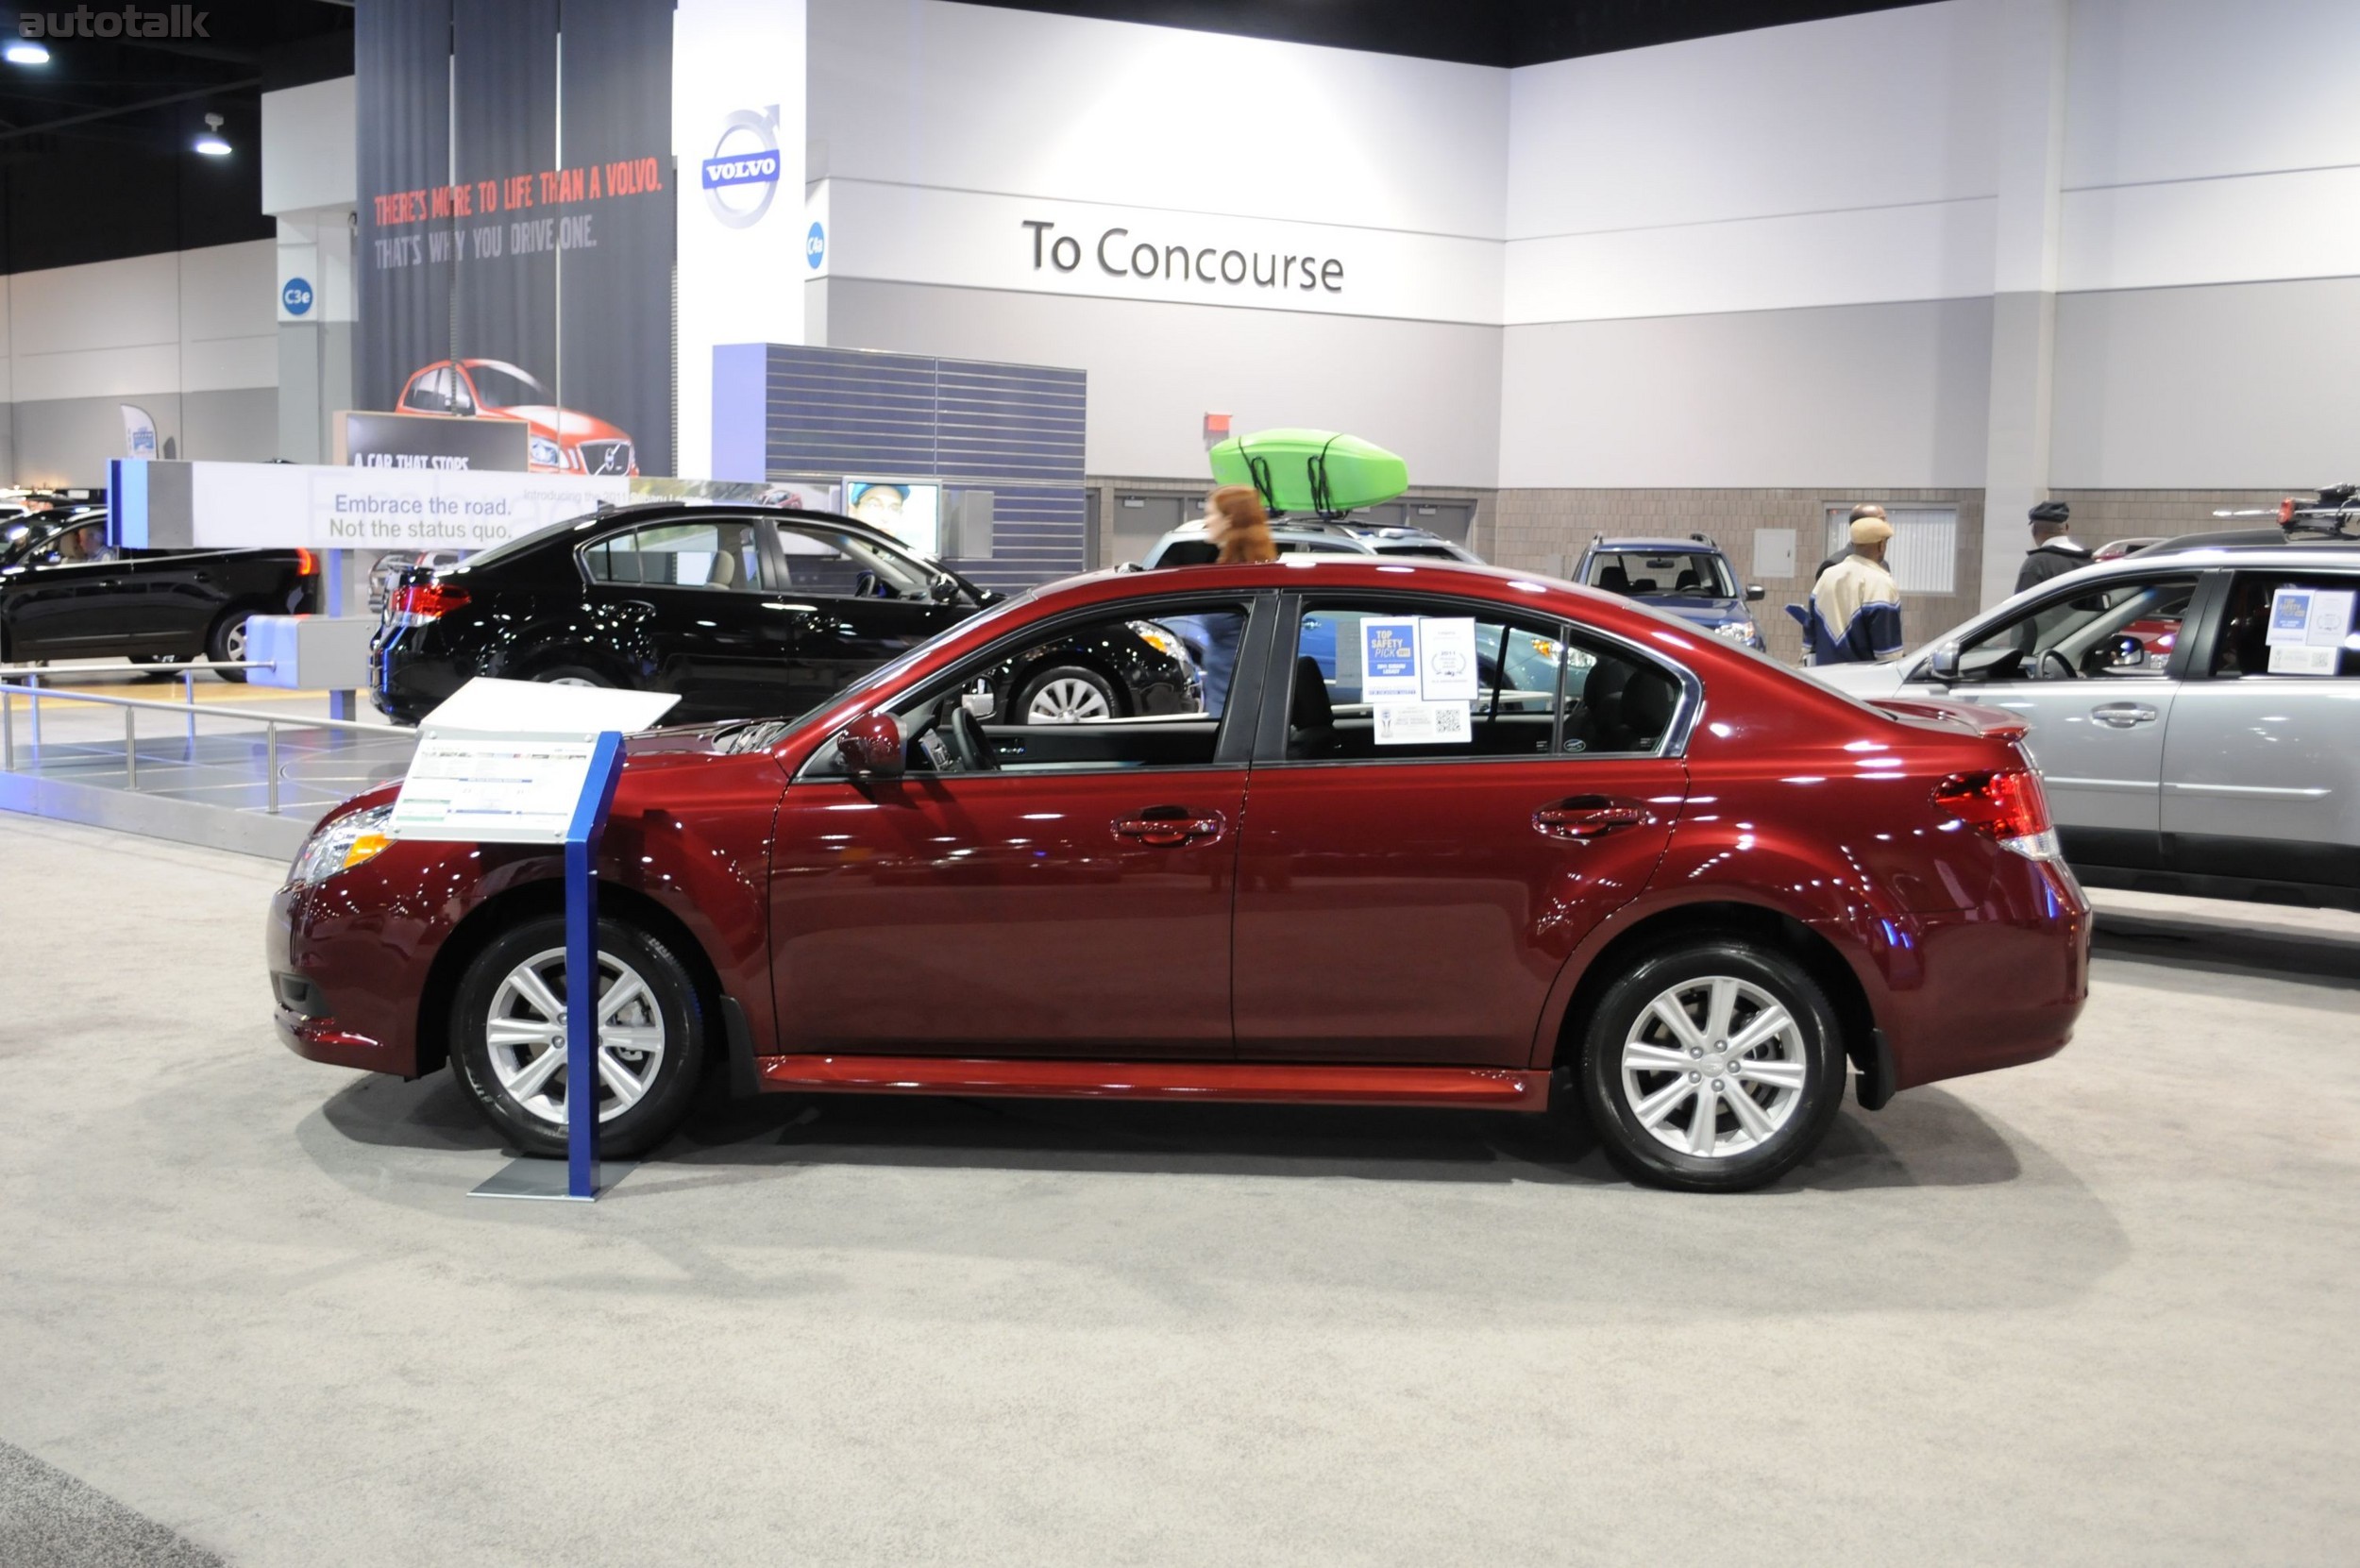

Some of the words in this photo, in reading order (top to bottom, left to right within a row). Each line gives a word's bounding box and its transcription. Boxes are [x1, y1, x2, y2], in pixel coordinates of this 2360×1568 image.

[706, 157, 777, 182] VOLVO
[374, 190, 428, 227] THERE'S
[431, 184, 472, 219] MORE
[478, 179, 497, 213] TO
[504, 175, 533, 211] LIFE
[539, 167, 584, 205] THAN
[589, 165, 601, 200] A
[605, 157, 663, 197] VOLVO.
[375, 234, 422, 269] THAT'S
[429, 230, 465, 263] WHY
[473, 226, 502, 260] YOU
[511, 218, 554, 255] DRIVE
[560, 214, 598, 250] ONE.
[1021, 219, 1082, 273] To
[1097, 227, 1344, 295] Concourse
[284, 289, 312, 305] C3e
[335, 494, 423, 514] Embrace
[429, 497, 459, 514] the
[464, 498, 512, 516] road.
[329, 518, 364, 538] Not
[371, 520, 401, 538] the
[408, 522, 466, 540] status
[472, 524, 512, 542] quo.
[1371, 638, 1403, 649] SAFETY
[1376, 630, 1392, 639] TOP
[1374, 648, 1395, 658] PICK
